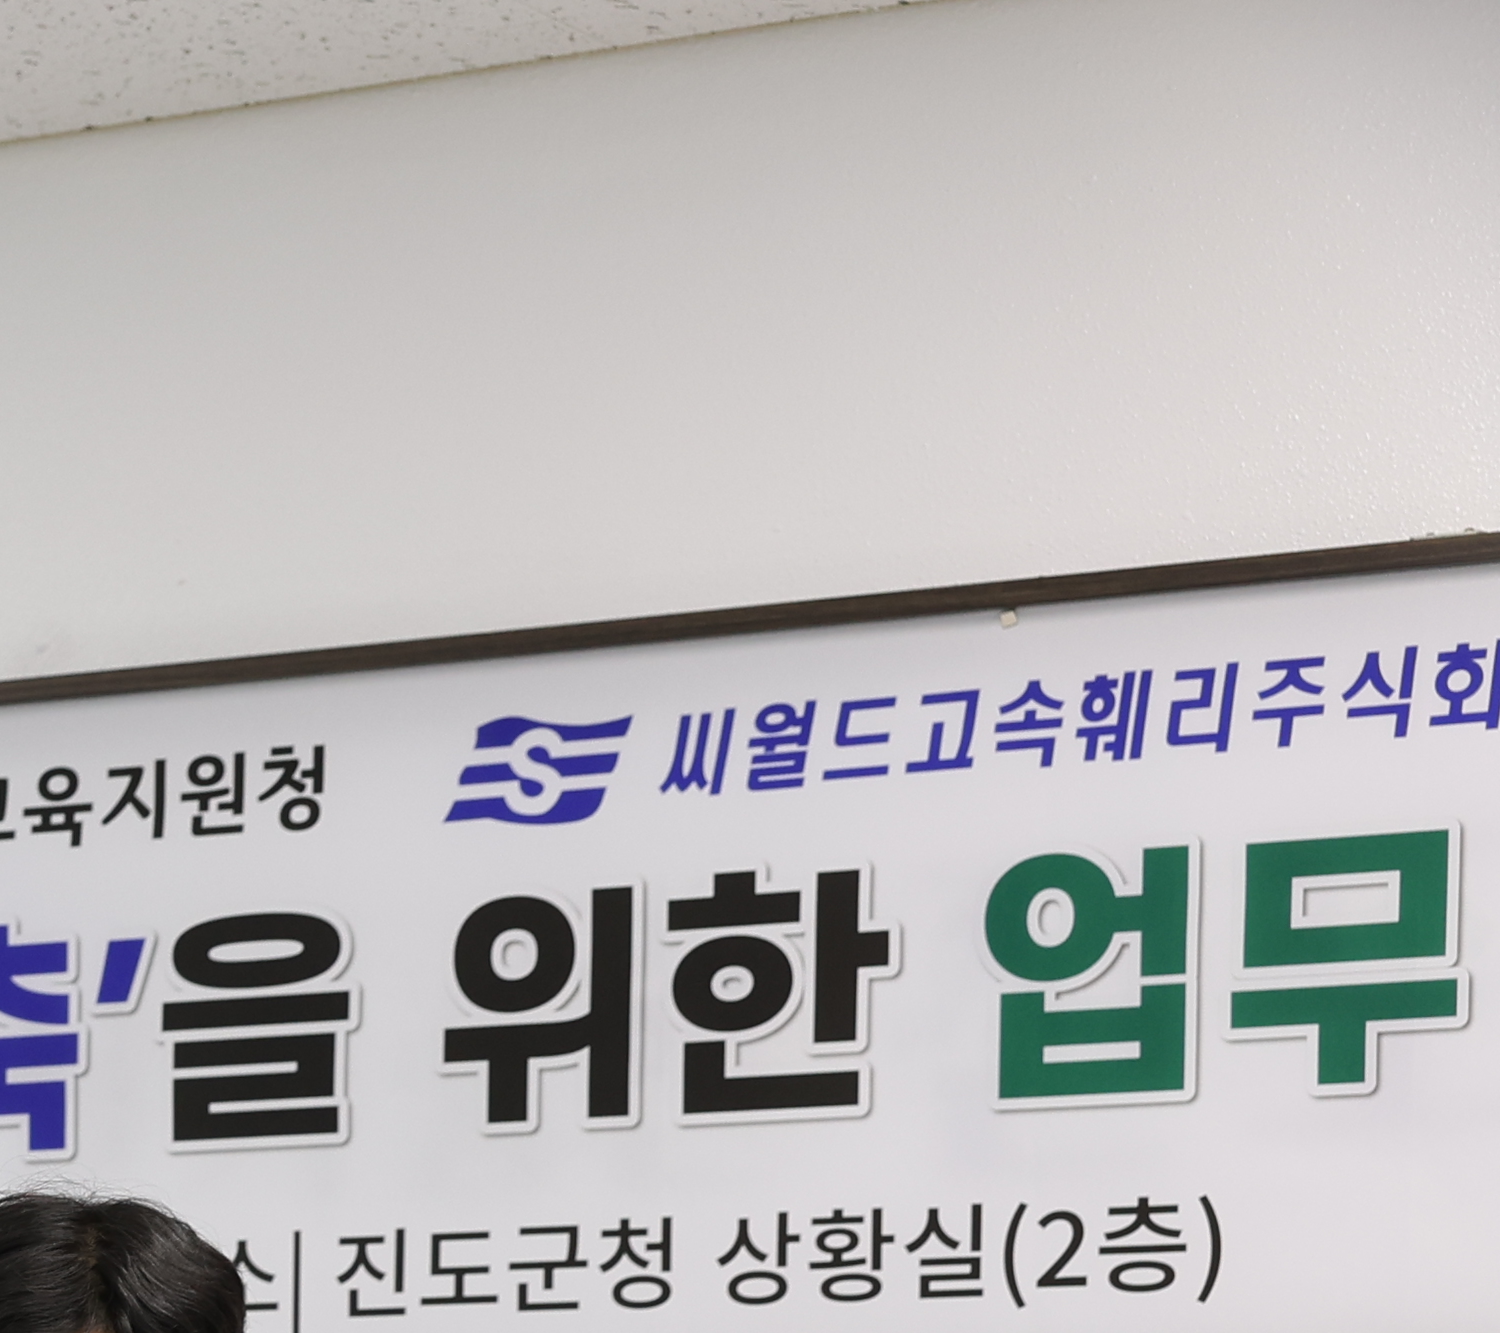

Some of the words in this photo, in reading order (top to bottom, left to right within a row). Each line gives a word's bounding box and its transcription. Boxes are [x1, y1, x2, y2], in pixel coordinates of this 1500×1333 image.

[659, 638, 1500, 797] 씨월드고속훼리주식회
[442, 867, 890, 1126] 위한
[984, 828, 1459, 1100] 업무
[336, 1216, 673, 1318] 진도군청
[716, 1194, 1222, 1309] 상황실(2층)
